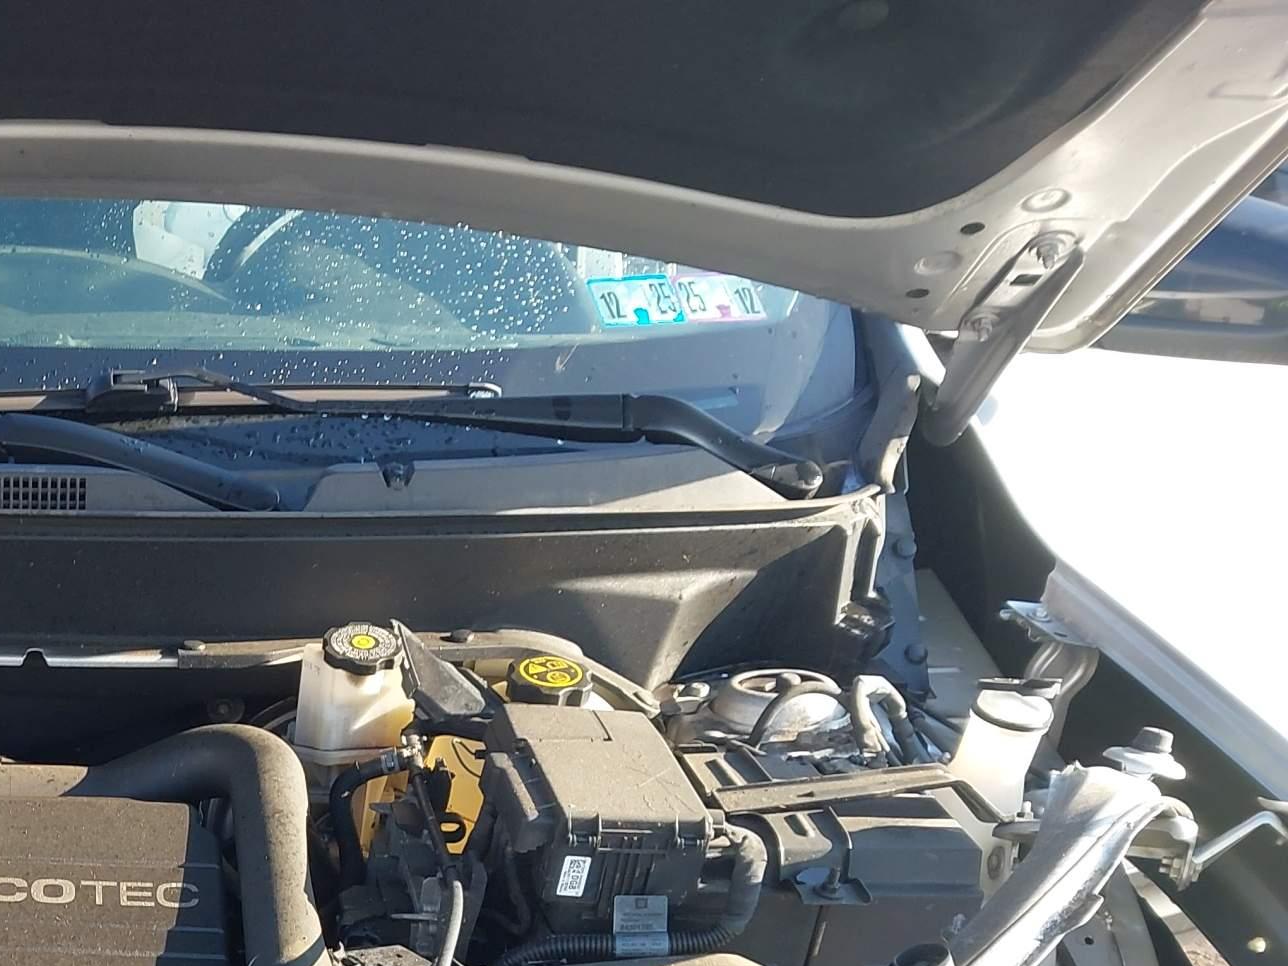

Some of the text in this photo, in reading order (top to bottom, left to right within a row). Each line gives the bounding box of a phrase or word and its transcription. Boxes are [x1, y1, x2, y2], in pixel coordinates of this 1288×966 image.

[600, 282, 677, 319] 12 25
[678, 281, 761, 315] 25 12
